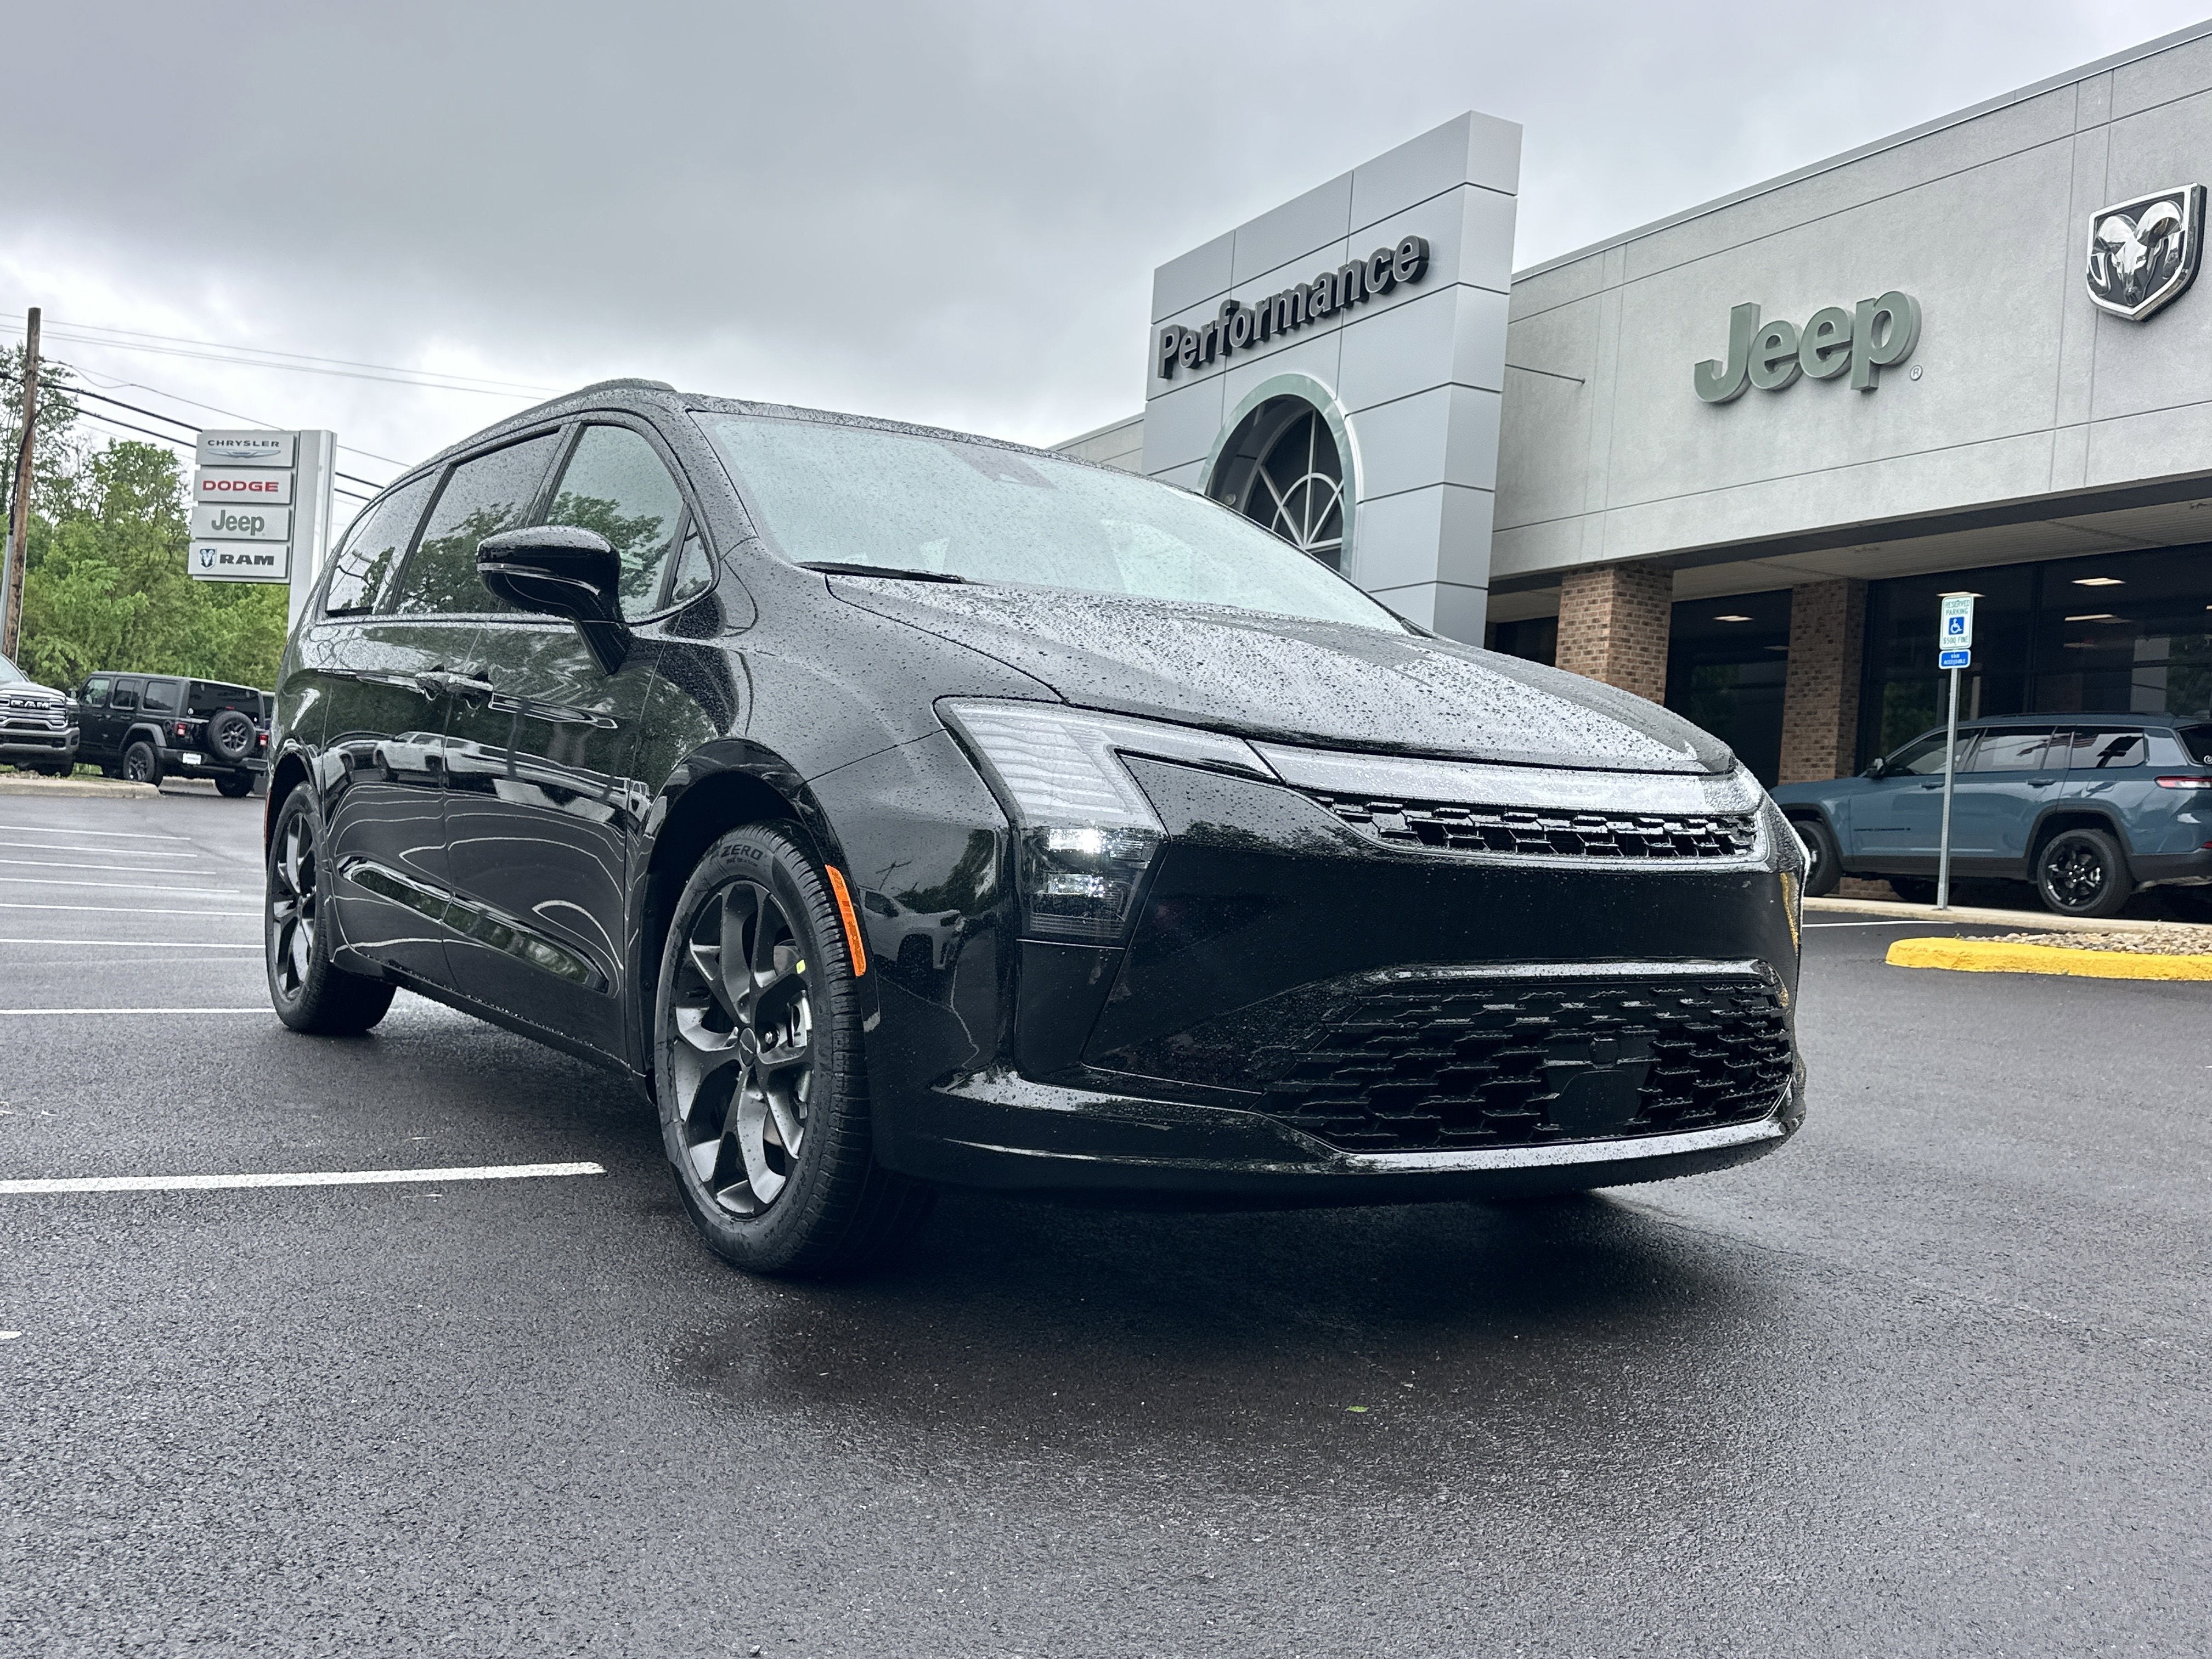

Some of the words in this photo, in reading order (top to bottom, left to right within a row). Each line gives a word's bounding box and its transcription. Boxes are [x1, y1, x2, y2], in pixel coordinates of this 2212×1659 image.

[1157, 235, 1430, 379] Performance
[1694, 290, 1922, 403] Jeep
[207, 439, 280, 448] CHRYSLER
[202, 480, 279, 493] DODGE
[211, 509, 265, 536] Jeep
[219, 554, 275, 566] RAM
[721, 844, 764, 861] ZERO
